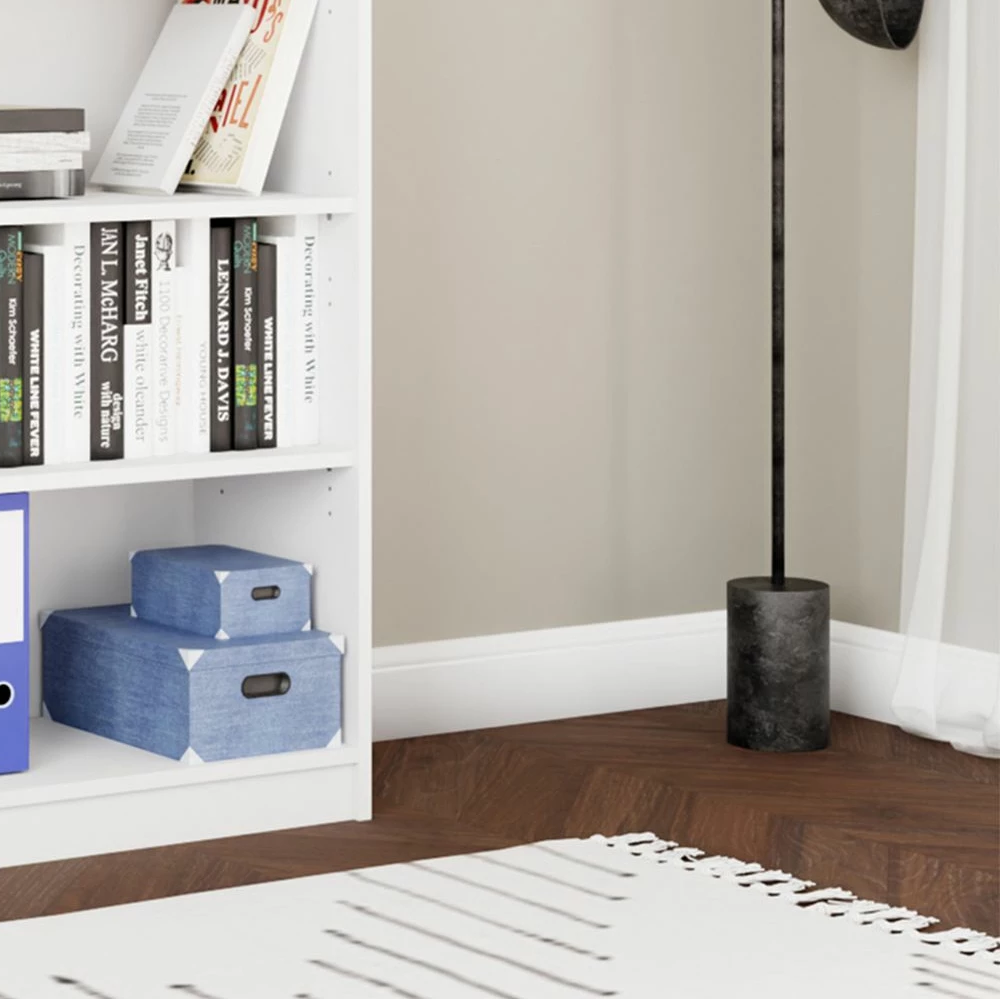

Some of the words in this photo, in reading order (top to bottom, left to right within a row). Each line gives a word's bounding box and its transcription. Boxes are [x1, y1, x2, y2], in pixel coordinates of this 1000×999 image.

[100, 227, 119, 256] JAN
[134, 234, 149, 276] Janet
[71, 244, 86, 330] Decorating
[101, 259, 118, 276] L.
[302, 236, 316, 318] Decorating
[8, 298, 18, 316] Kim
[134, 278, 149, 321] Fitch
[158, 281, 171, 312] 1100
[216, 259, 230, 351] LENNARD
[244, 287, 253, 305] Kim
[8, 318, 18, 365] Schaefer
[100, 279, 119, 363] McHARG
[263, 317, 274, 360] WHITE
[304, 321, 316, 355] with
[29, 329, 40, 374] WHITE
[74, 333, 86, 368] with
[135, 329, 148, 371] white
[158, 315, 171, 388] Decorative
[216, 352, 230, 364] J.
[29, 377, 40, 410] LINE
[74, 372, 86, 419] White
[100, 381, 111, 407] with
[216, 365, 230, 422] DAVIS
[263, 362, 274, 393] LINE
[304, 358, 316, 404] White
[100, 408, 111, 448] nature
[109, 393, 124, 430] design
[135, 374, 148, 443] oleander
[155, 391, 171, 443] Designs
[263, 396, 274, 441] FEVER
[29, 412, 40, 458] FEVER
